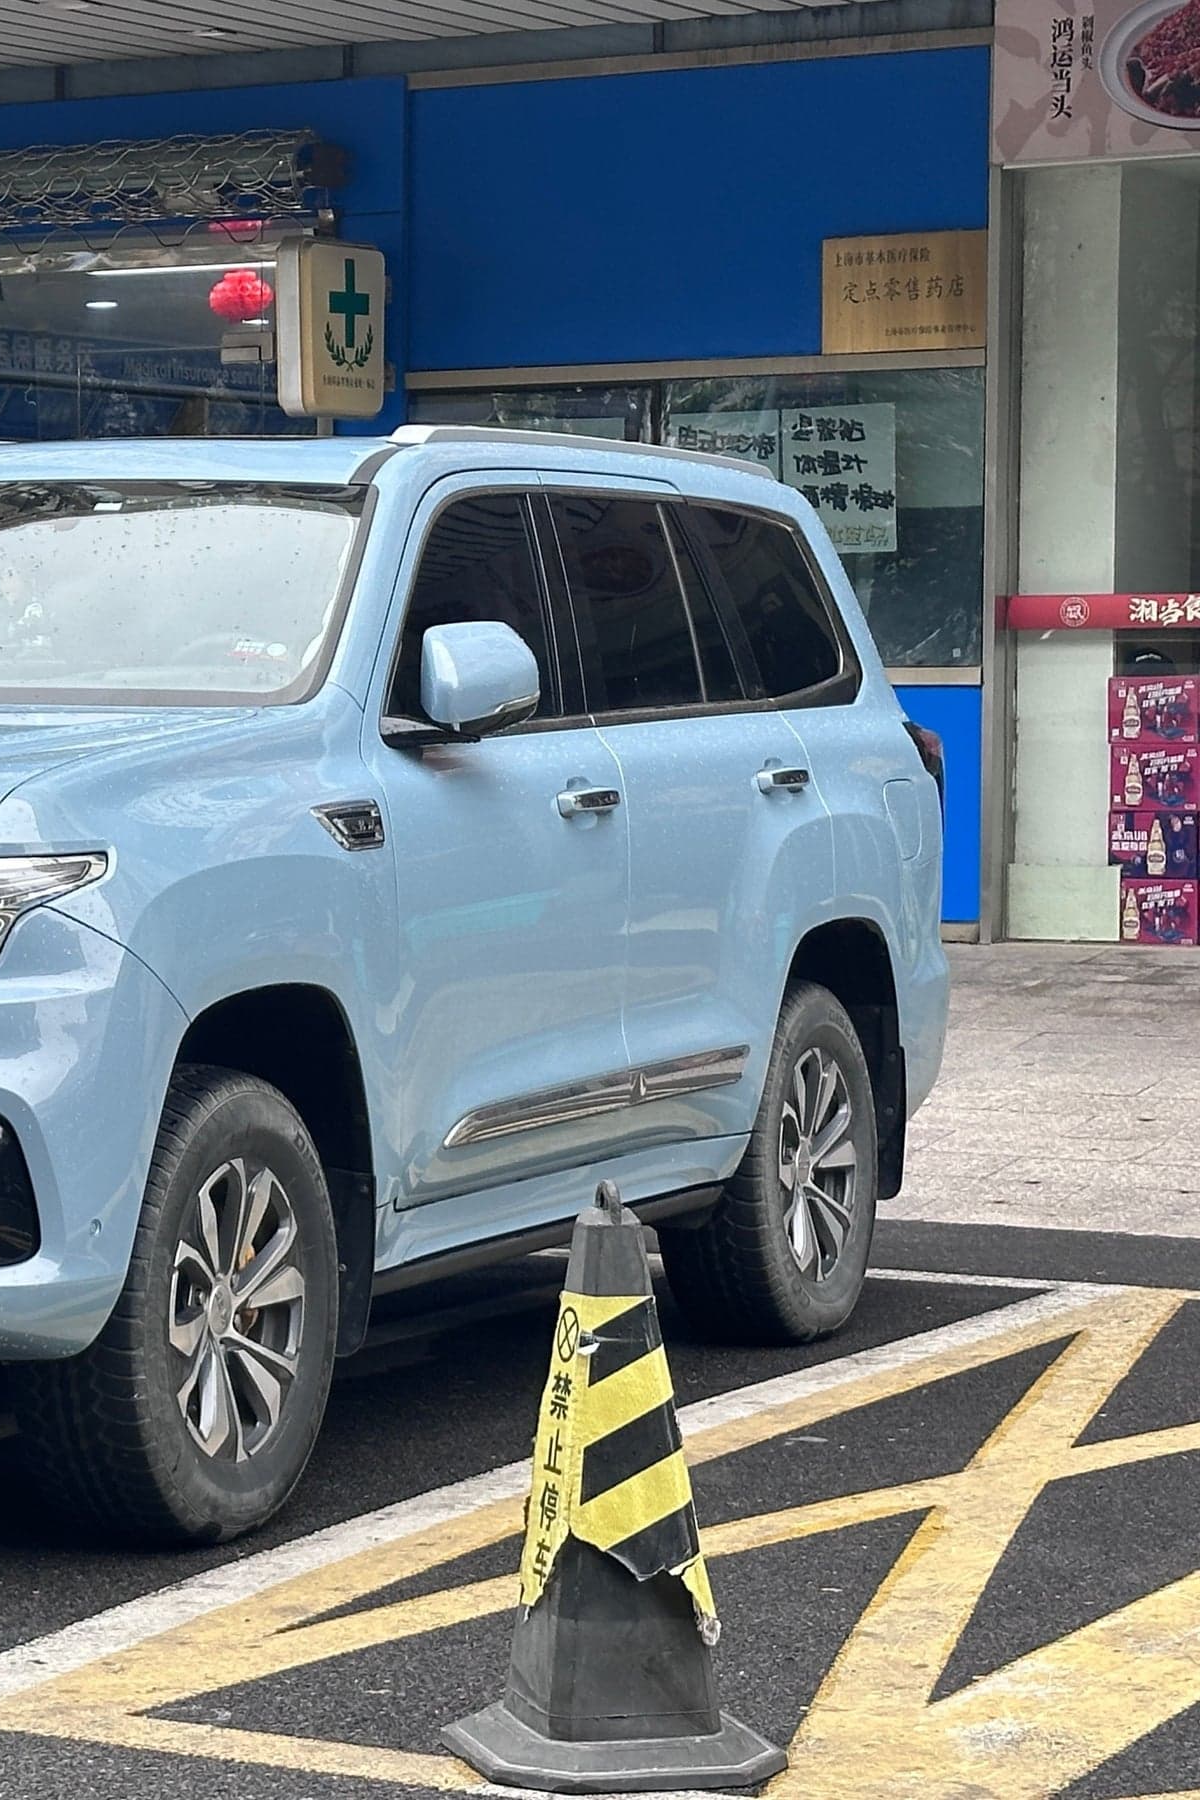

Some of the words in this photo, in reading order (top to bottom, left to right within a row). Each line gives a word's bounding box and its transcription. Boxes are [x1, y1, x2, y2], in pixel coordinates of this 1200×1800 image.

[1050, 17, 1074, 119] 鸿运当头
[843, 275, 965, 304] 定点零售药店
[532, 1371, 572, 1588] 禁止停车
